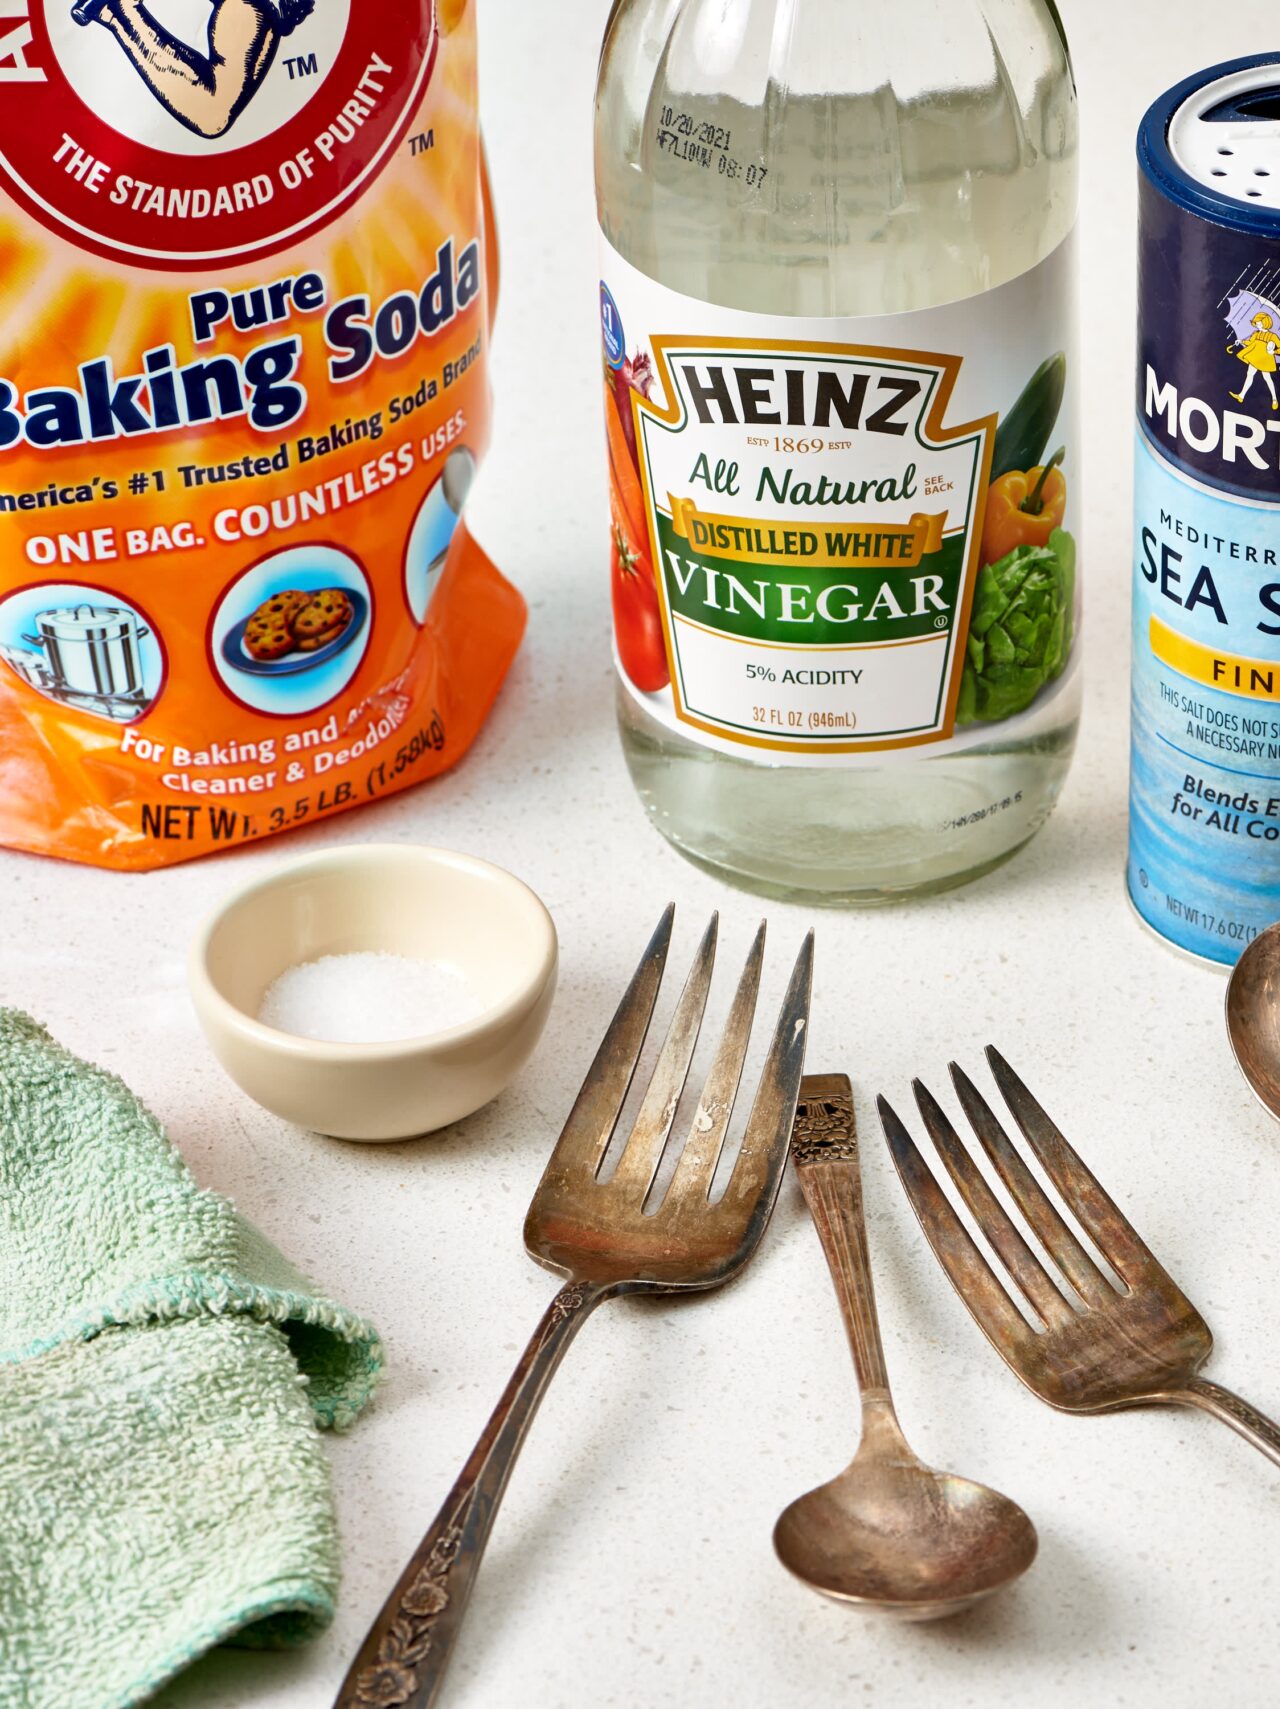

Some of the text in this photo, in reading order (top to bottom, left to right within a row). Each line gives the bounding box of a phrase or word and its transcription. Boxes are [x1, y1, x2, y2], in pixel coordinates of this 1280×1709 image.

[282, 52, 318, 81] TM
[52, 51, 395, 219] THE STANDARD OF PURITY
[408, 129, 435, 156] TM
[660, 105, 731, 151] 10/20/2021
[190, 270, 326, 343] Pure
[325, 237, 481, 382] Soda
[0, 328, 482, 512] merica's #1 Trusted Baking Soda Brand
[680, 365, 922, 437] HEINZ
[773, 437, 824, 454] 1869
[26, 408, 468, 564] ONE BAG. COUNTLESS USES.
[688, 452, 918, 506] All Natural
[924, 474, 945, 488] SEE
[924, 481, 954, 496] BACK
[691, 519, 915, 559] DISTILLED WHITE
[665, 549, 950, 623] VINEGAR
[1141, 526, 1229, 625] SEA
[746, 663, 863, 685] 5% ACIDITY
[752, 706, 857, 730] 32 FL OZ (946mL)
[1160, 681, 1179, 708] THIS
[1181, 696, 1204, 720] SALT
[1206, 707, 1239, 731] DOES
[1242, 719, 1268, 738] NOT
[120, 715, 339, 767] For Baking and
[1186, 721, 1194, 738] A
[1195, 723, 1265, 759] NECESSARY
[141, 803, 201, 840] NET
[268, 797, 310, 832] 3.5
[316, 781, 358, 811] LB.
[366, 707, 445, 796] (1.58kg)
[162, 770, 277, 795] Cleaner
[285, 761, 304, 783] &
[1183, 774, 1259, 814] Blends
[1171, 793, 1203, 821] for
[1205, 810, 1240, 834] All
[1166, 895, 1183, 917] NET
[1184, 905, 1199, 924] WT
[1201, 914, 1225, 935] 17.6
[1228, 922, 1244, 940] OZ
